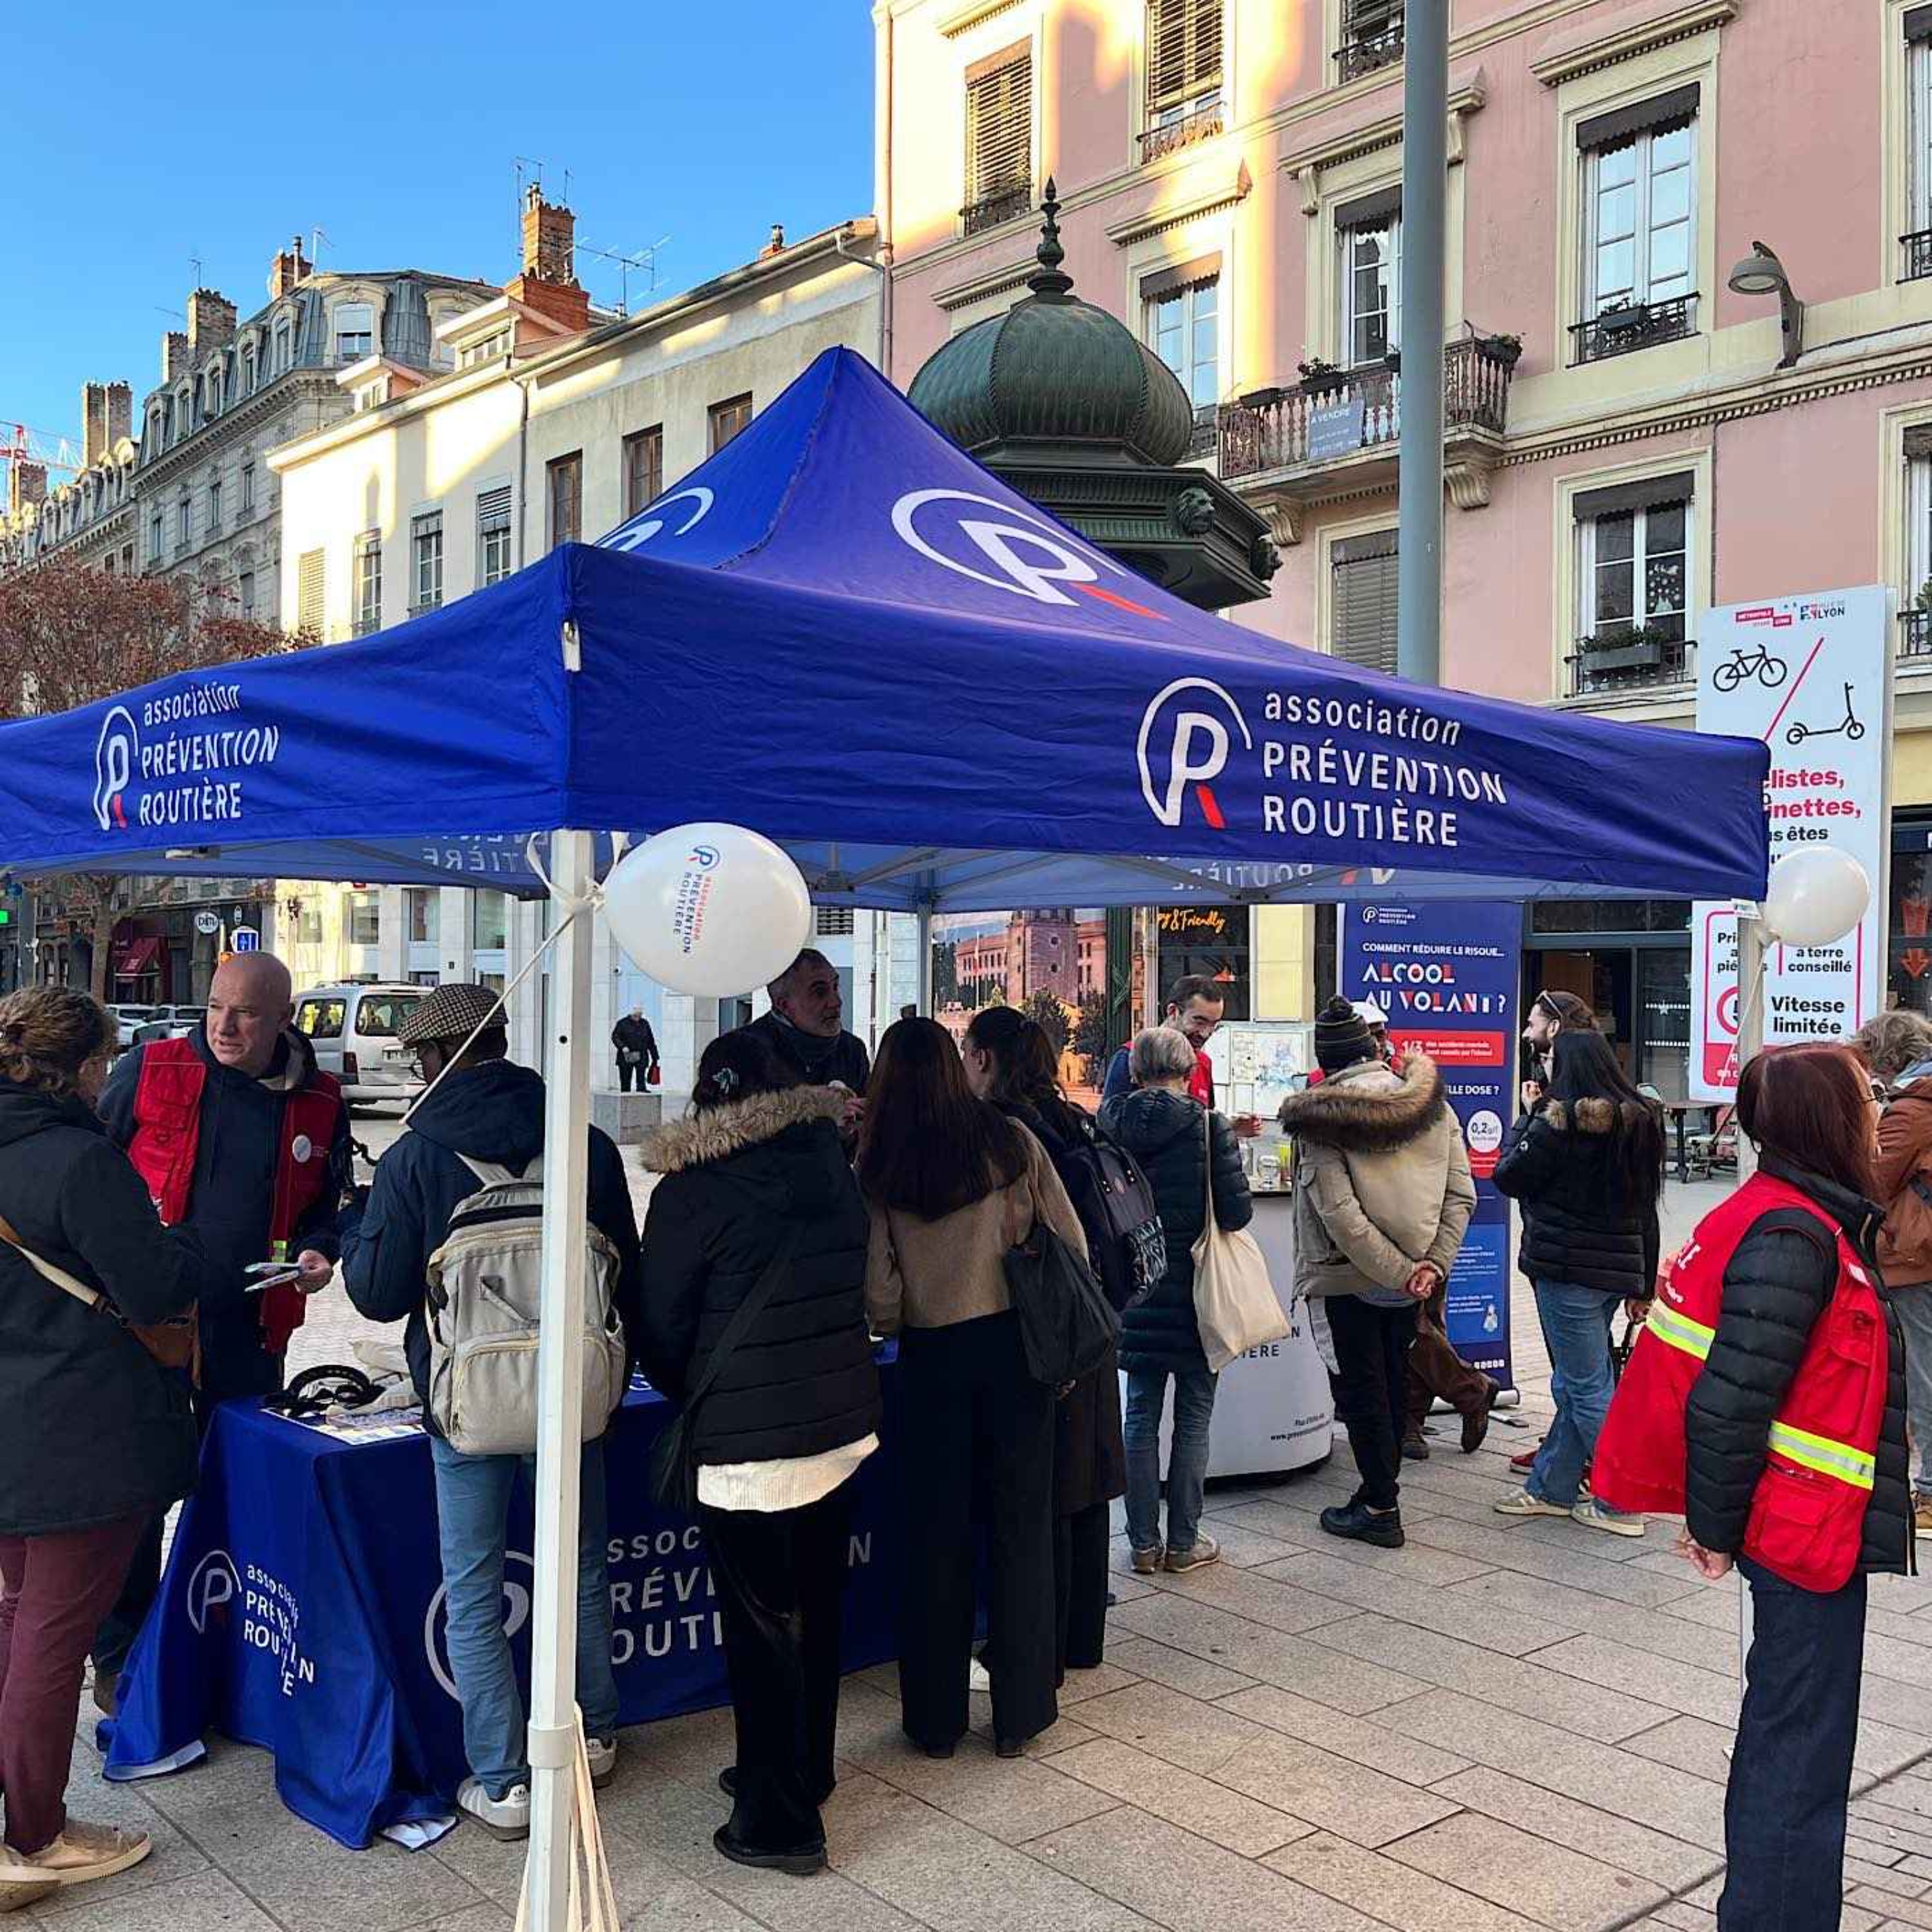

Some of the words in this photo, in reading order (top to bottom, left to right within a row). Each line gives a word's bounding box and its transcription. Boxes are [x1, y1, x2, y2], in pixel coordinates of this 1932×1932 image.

[1818, 607, 1845, 619] LYON
[144, 681, 240, 726] association
[1264, 692, 1461, 746] association
[141, 724, 279, 779] PRÉVENTION
[1263, 739, 1508, 805] PRÉVENTION
[139, 777, 243, 827] ROUTIÈRE
[1263, 795, 1458, 847] ROUTIÈRE
[1786, 826, 1828, 841] êtes
[1363, 942, 1410, 953] COMMENT
[1412, 943, 1452, 954] RÉDUIRE
[1453, 945, 1463, 955] LE
[1807, 947, 1844, 958] terre
[1362, 962, 1455, 983] ALCOOL
[1788, 960, 1852, 972] conseillé
[1365, 990, 1392, 1010] AU
[1399, 991, 1491, 1013] VOLANT
[1498, 994, 1506, 1014] ?
[1771, 996, 1844, 1013] Vitesse
[1774, 1016, 1842, 1034] limitée
[1465, 1085, 1492, 1095] DOSE
[1493, 1086, 1499, 1095] ?
